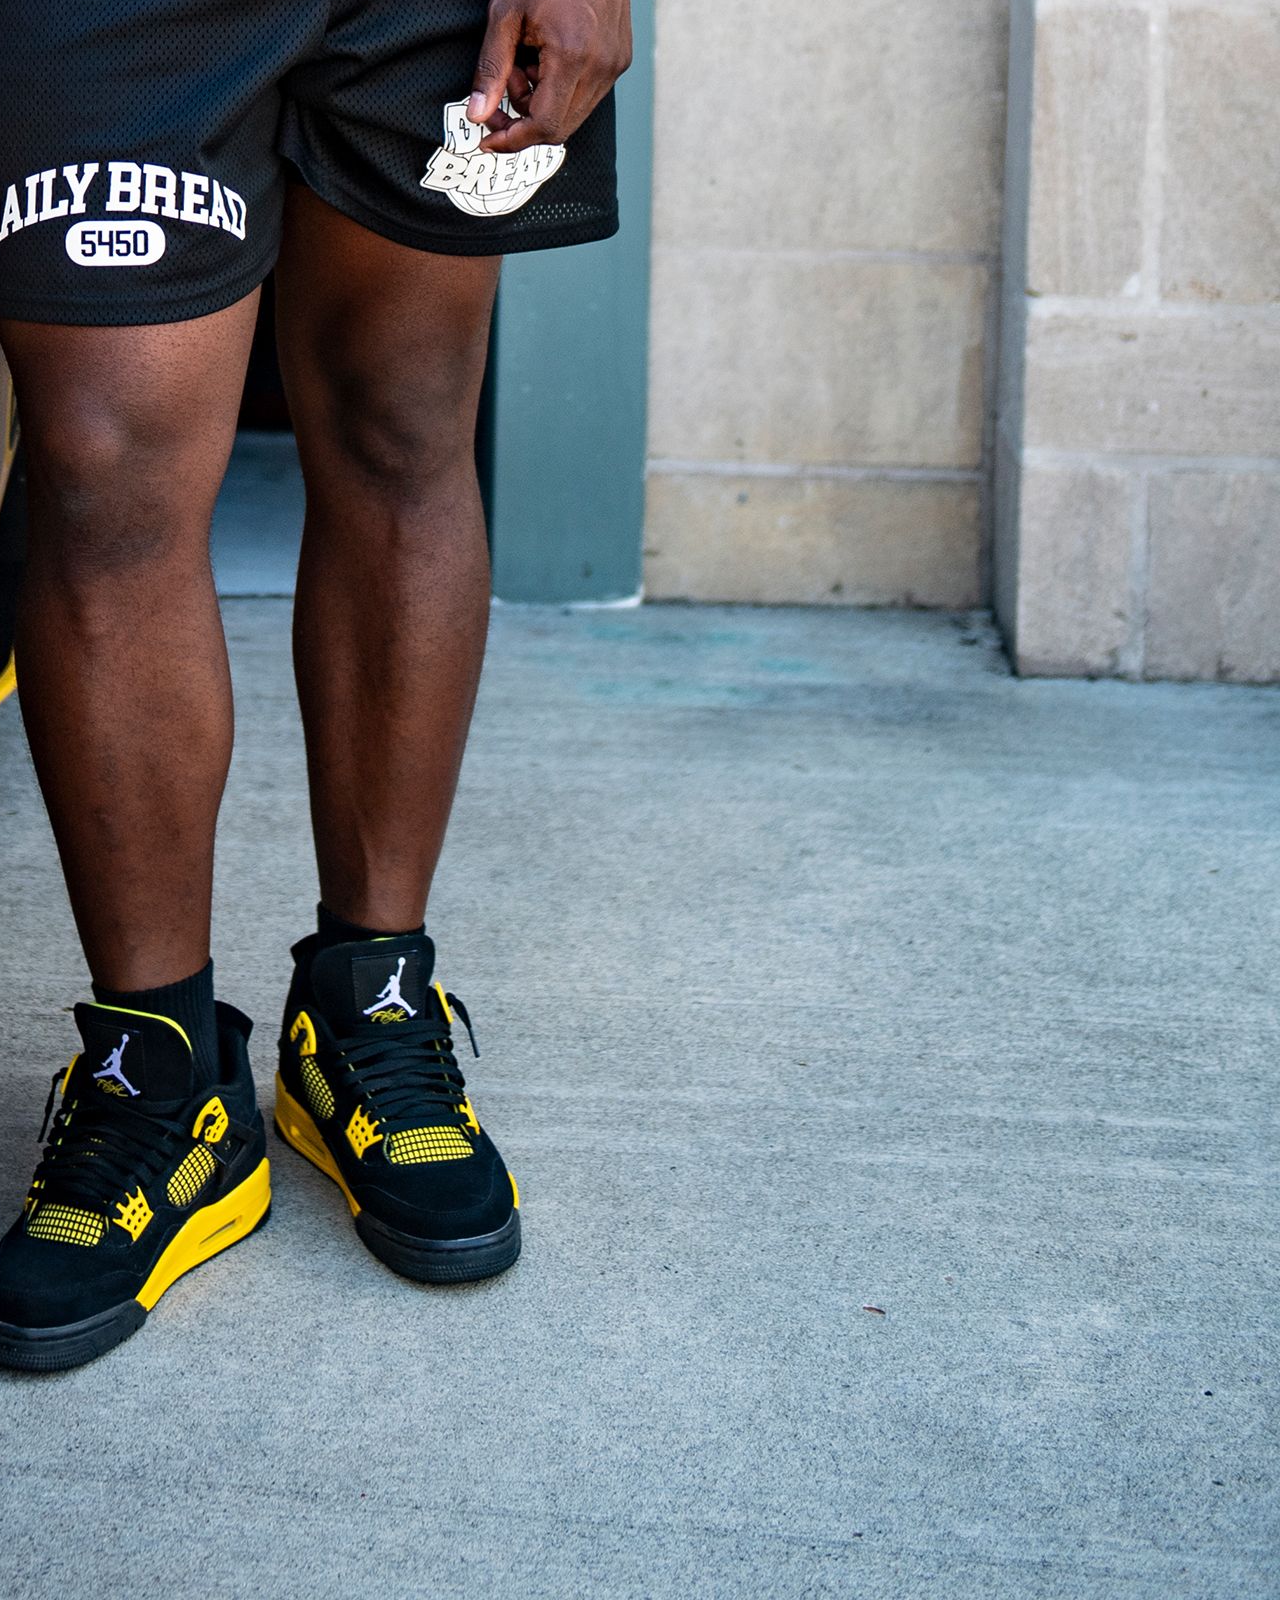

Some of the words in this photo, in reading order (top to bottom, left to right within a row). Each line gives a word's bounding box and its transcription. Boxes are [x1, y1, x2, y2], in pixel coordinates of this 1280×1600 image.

[422, 144, 565, 196] BREAD
[105, 161, 247, 241] BREAD
[80, 229, 150, 258] 5450
